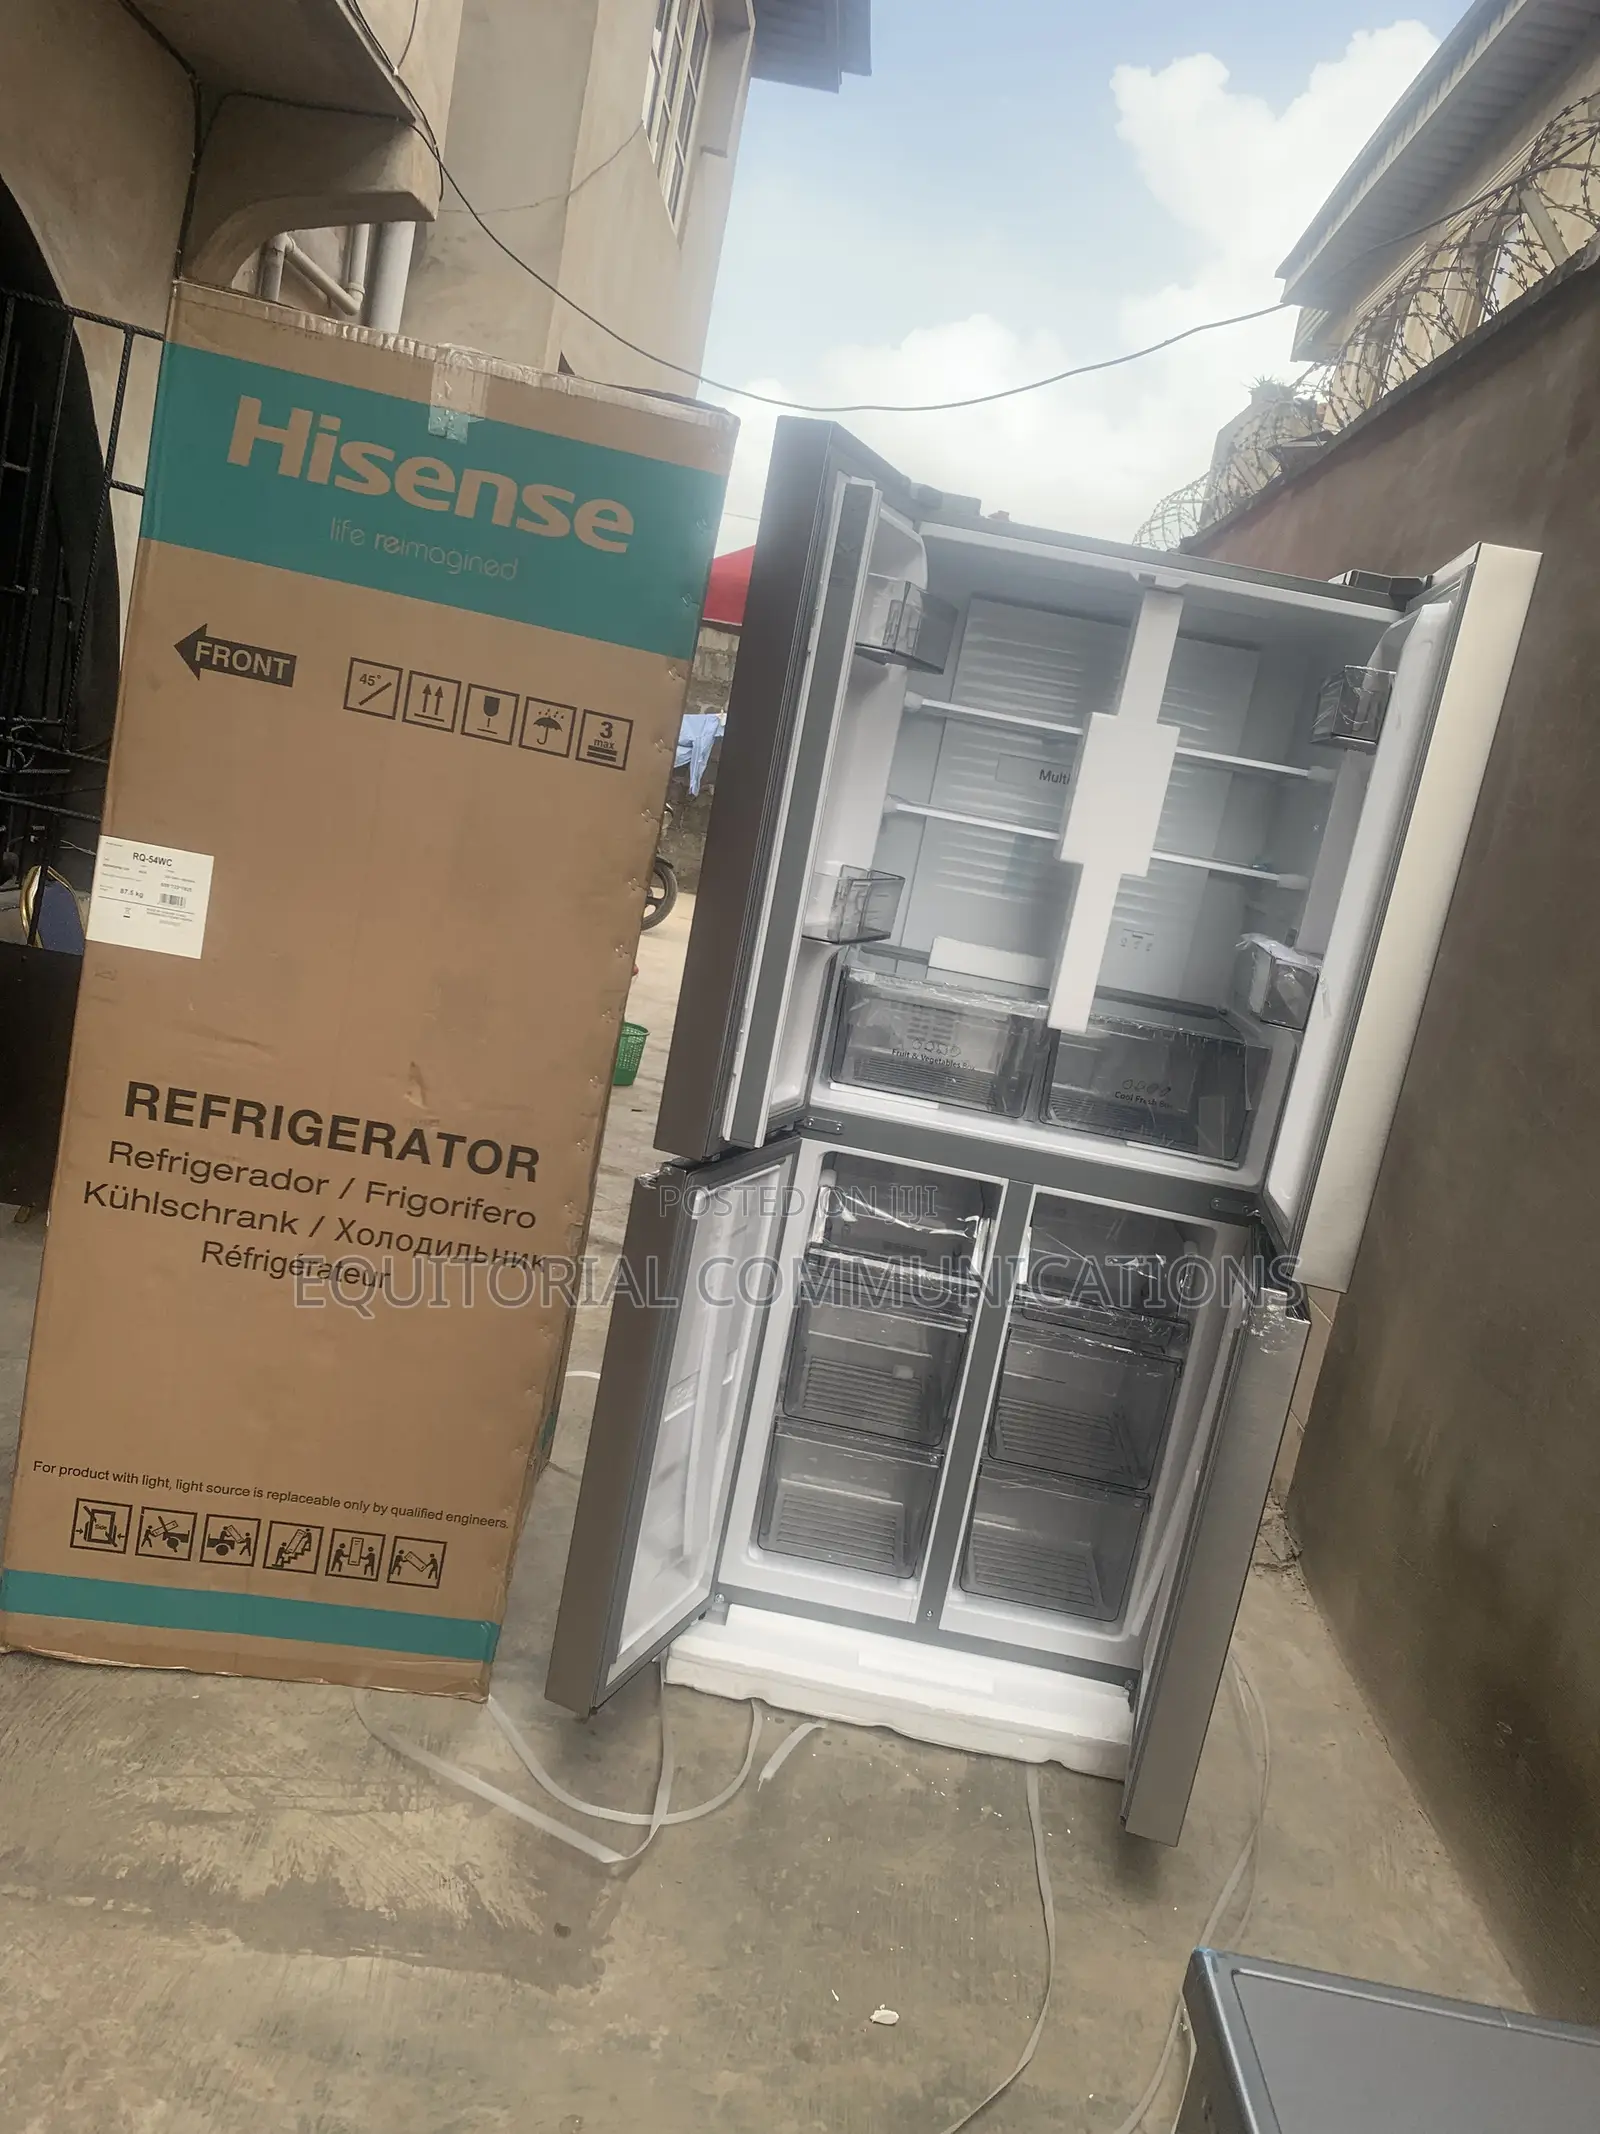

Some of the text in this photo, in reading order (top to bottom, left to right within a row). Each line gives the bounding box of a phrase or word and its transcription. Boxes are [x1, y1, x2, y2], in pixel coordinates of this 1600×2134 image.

[227, 394, 635, 554] Hisense
[330, 517, 520, 581] life reimagined
[194, 640, 290, 680] FRONT
[593, 739, 616, 750] max
[599, 721, 613, 739] 3
[1038, 768, 1071, 785] Multi
[132, 852, 173, 867] RQ-54WC
[891, 1048, 910, 1058] Fruit
[921, 1053, 961, 1069] Vegetables
[1114, 1091, 1134, 1101] Cool
[124, 1080, 540, 1183] REFRIGERATOR
[108, 1140, 330, 1196] Refrigerador
[365, 1180, 536, 1229] Frigorifero
[83, 1181, 299, 1236] Kühlschrank
[334, 1217, 546, 1274] Холодильник
[201, 1240, 391, 1289] Réfrigérateur
[33, 1460, 509, 1529] For product with light, light source is replaceable only by qualified engineers.
